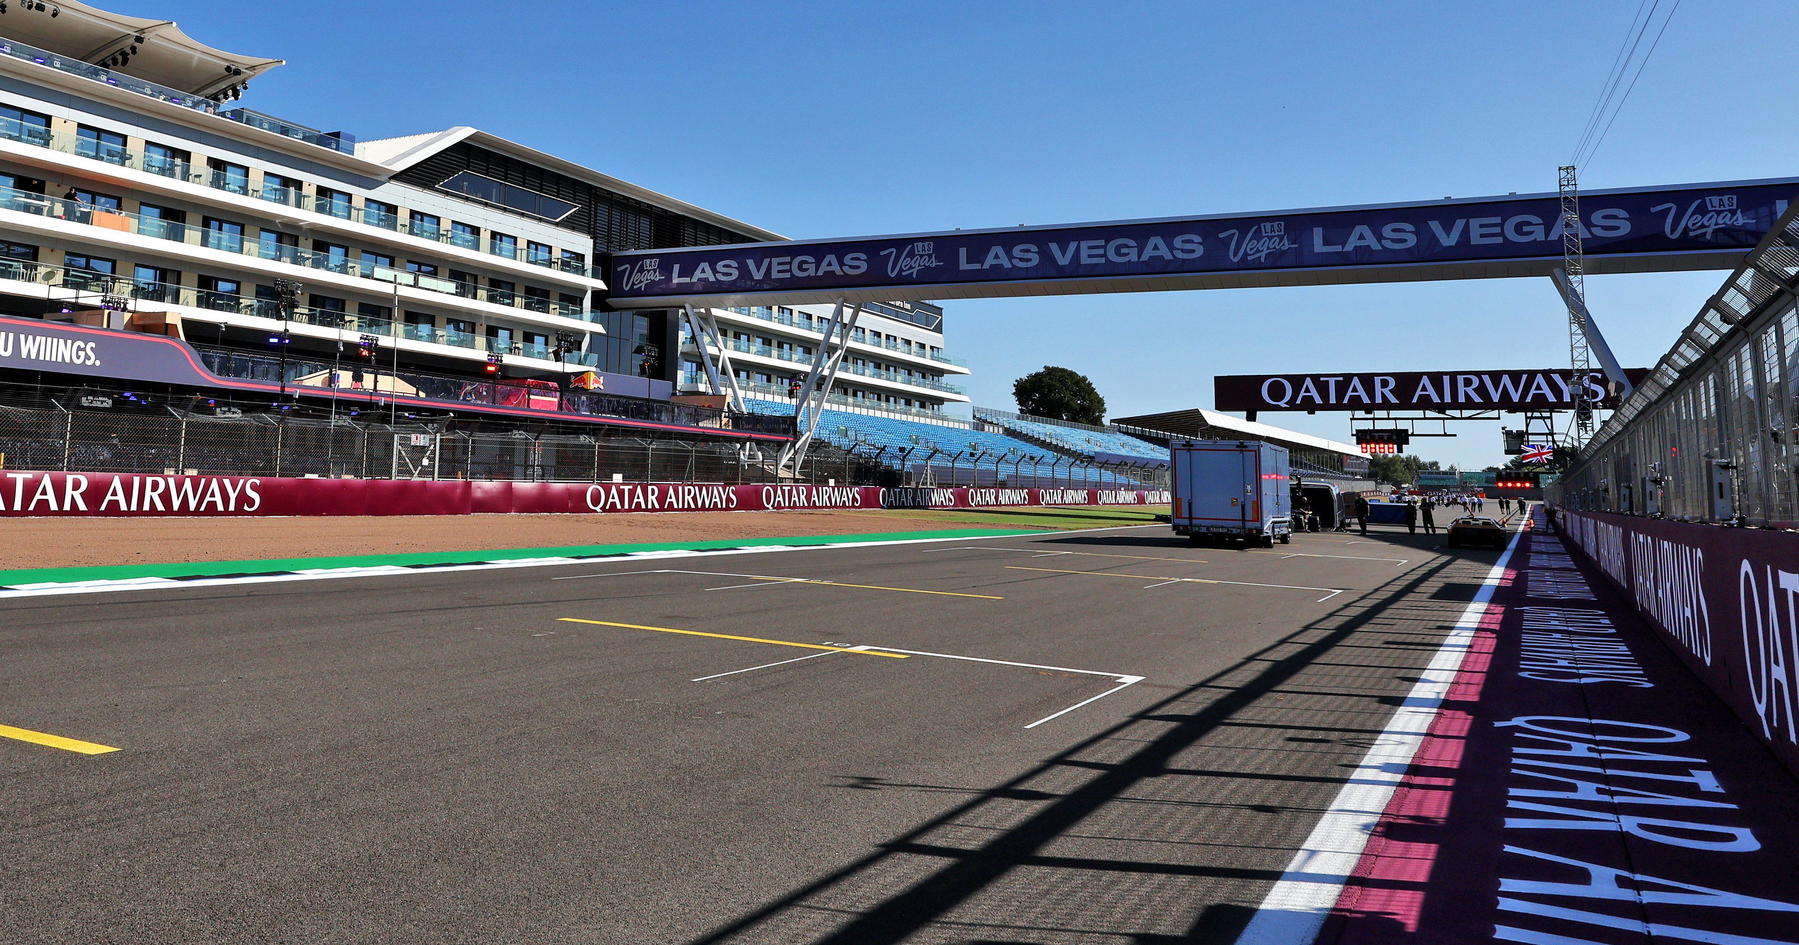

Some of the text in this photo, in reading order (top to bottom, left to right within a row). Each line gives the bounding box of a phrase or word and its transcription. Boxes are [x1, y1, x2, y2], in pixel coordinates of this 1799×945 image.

[1650, 199, 1757, 240] Vegas
[1705, 195, 1736, 211] LAS
[1218, 225, 1298, 263] Vegas
[1261, 221, 1284, 236] LAS
[1313, 208, 1632, 253] LAS VEGAS
[880, 243, 944, 279] Vegas
[915, 242, 933, 254] LAS
[959, 233, 1205, 270] LAS VEGAS
[617, 261, 665, 291] Vegas
[672, 252, 868, 284] LAS VEGAS
[20, 333, 101, 367] WIIINGS.
[1261, 372, 1606, 408] QATAR AIRWAYS
[0, 473, 261, 512] TAR AIRWAYS
[586, 484, 738, 512] QATAR AIRWAYS
[762, 485, 861, 510] QATAR AIRWAYS
[879, 488, 955, 508] QATAR AIRWAYS
[968, 488, 1029, 507] QATAR AIRWAYS
[1492, 716, 1762, 853] QATAR
